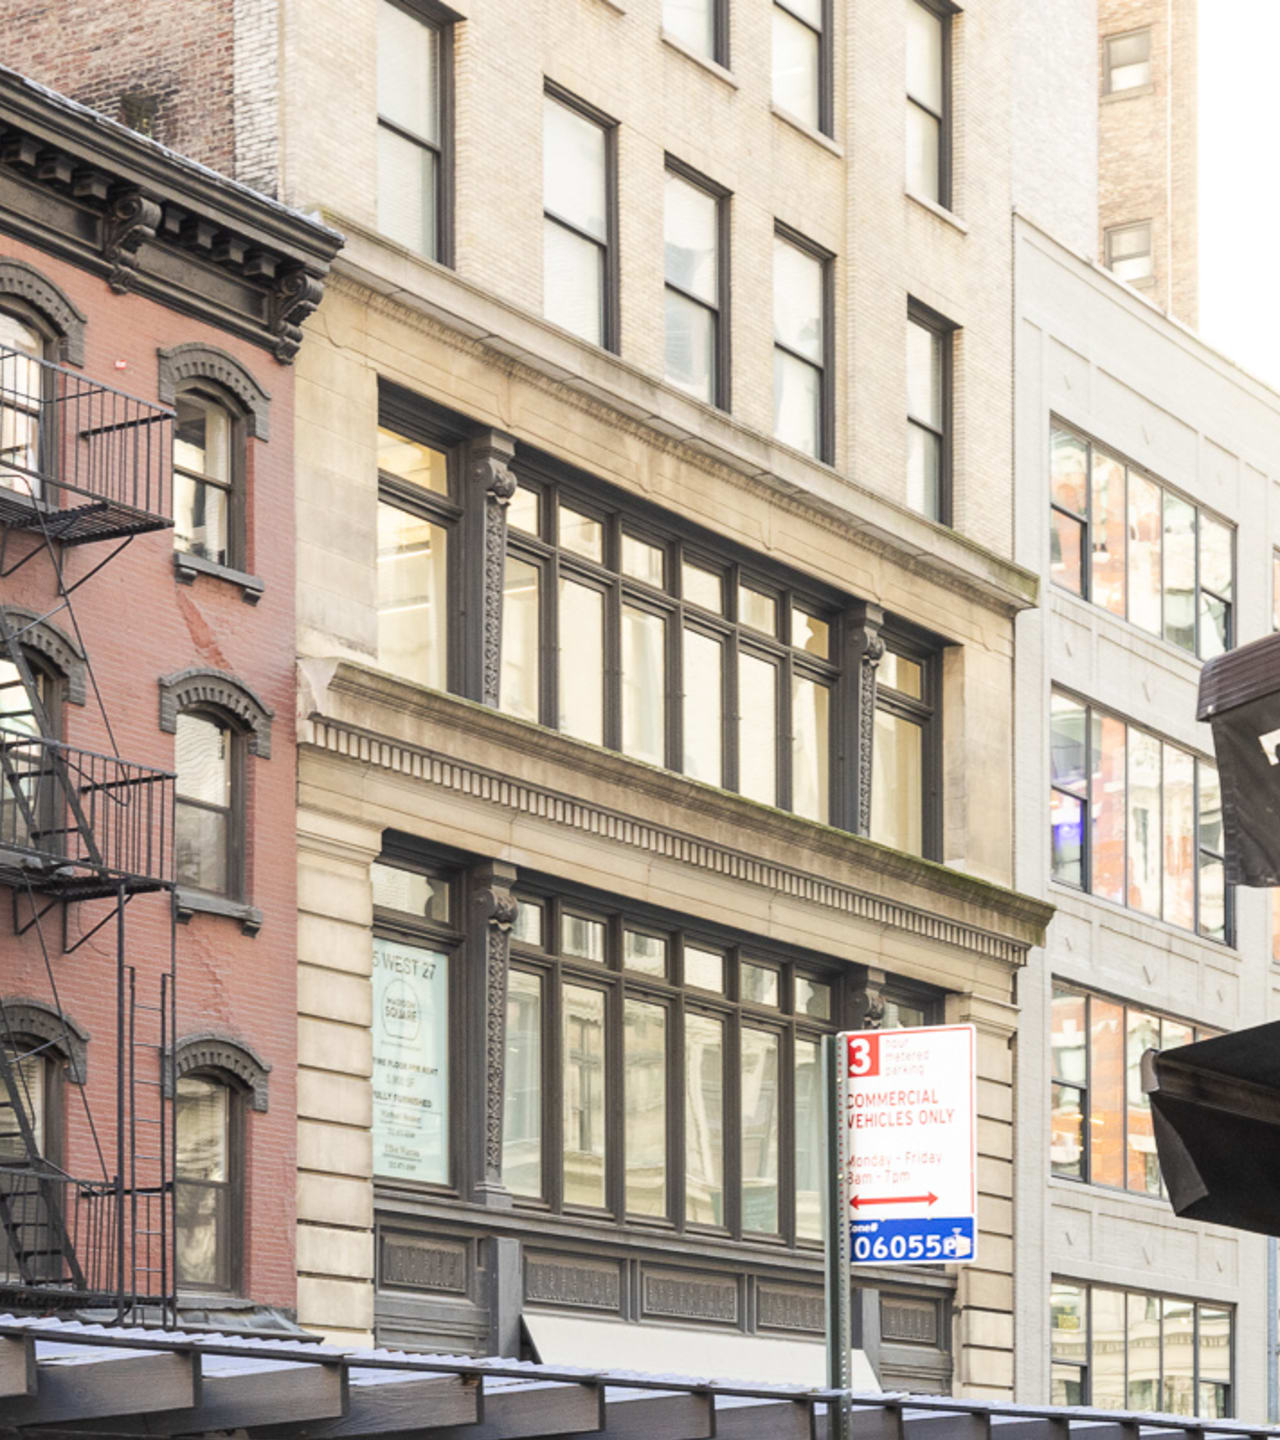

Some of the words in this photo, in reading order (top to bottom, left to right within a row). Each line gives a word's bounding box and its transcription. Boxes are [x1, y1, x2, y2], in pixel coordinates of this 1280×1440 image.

[381, 951, 419, 976] WEST
[422, 961, 437, 980] 27
[385, 1005, 417, 1022] SQUARE
[849, 1038, 871, 1075] 3
[885, 1049, 930, 1063] metered
[847, 1089, 939, 1110] COMMERCIAL
[919, 1108, 956, 1126] ONLY
[905, 1151, 943, 1167] Friday
